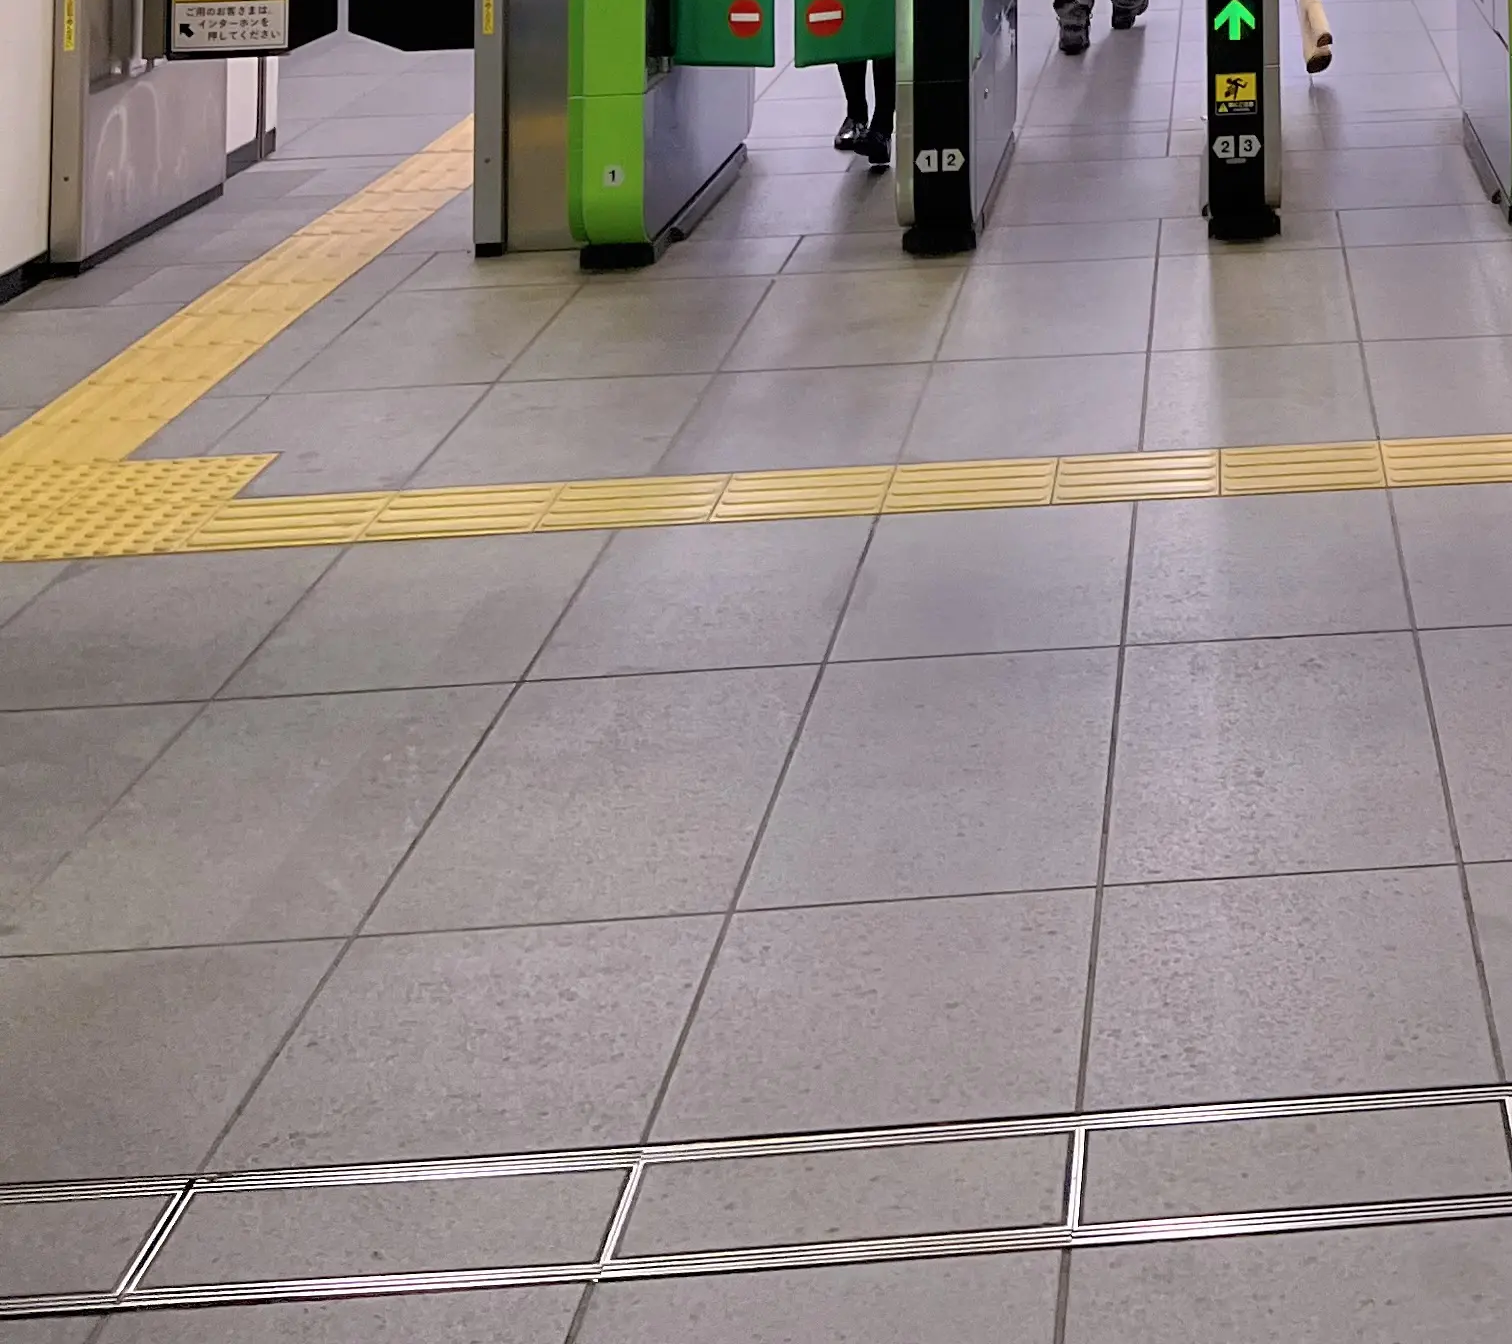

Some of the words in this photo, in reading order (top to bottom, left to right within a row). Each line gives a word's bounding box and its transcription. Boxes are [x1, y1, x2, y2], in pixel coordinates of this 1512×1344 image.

[198, 17, 269, 30] インターホンを
[207, 29, 281, 42] 押してください
[1220, 140, 1230, 153] 2
[1243, 139, 1253, 152] 3
[924, 154, 933, 168] 1
[946, 152, 957, 167] 2
[608, 169, 616, 183] 1
